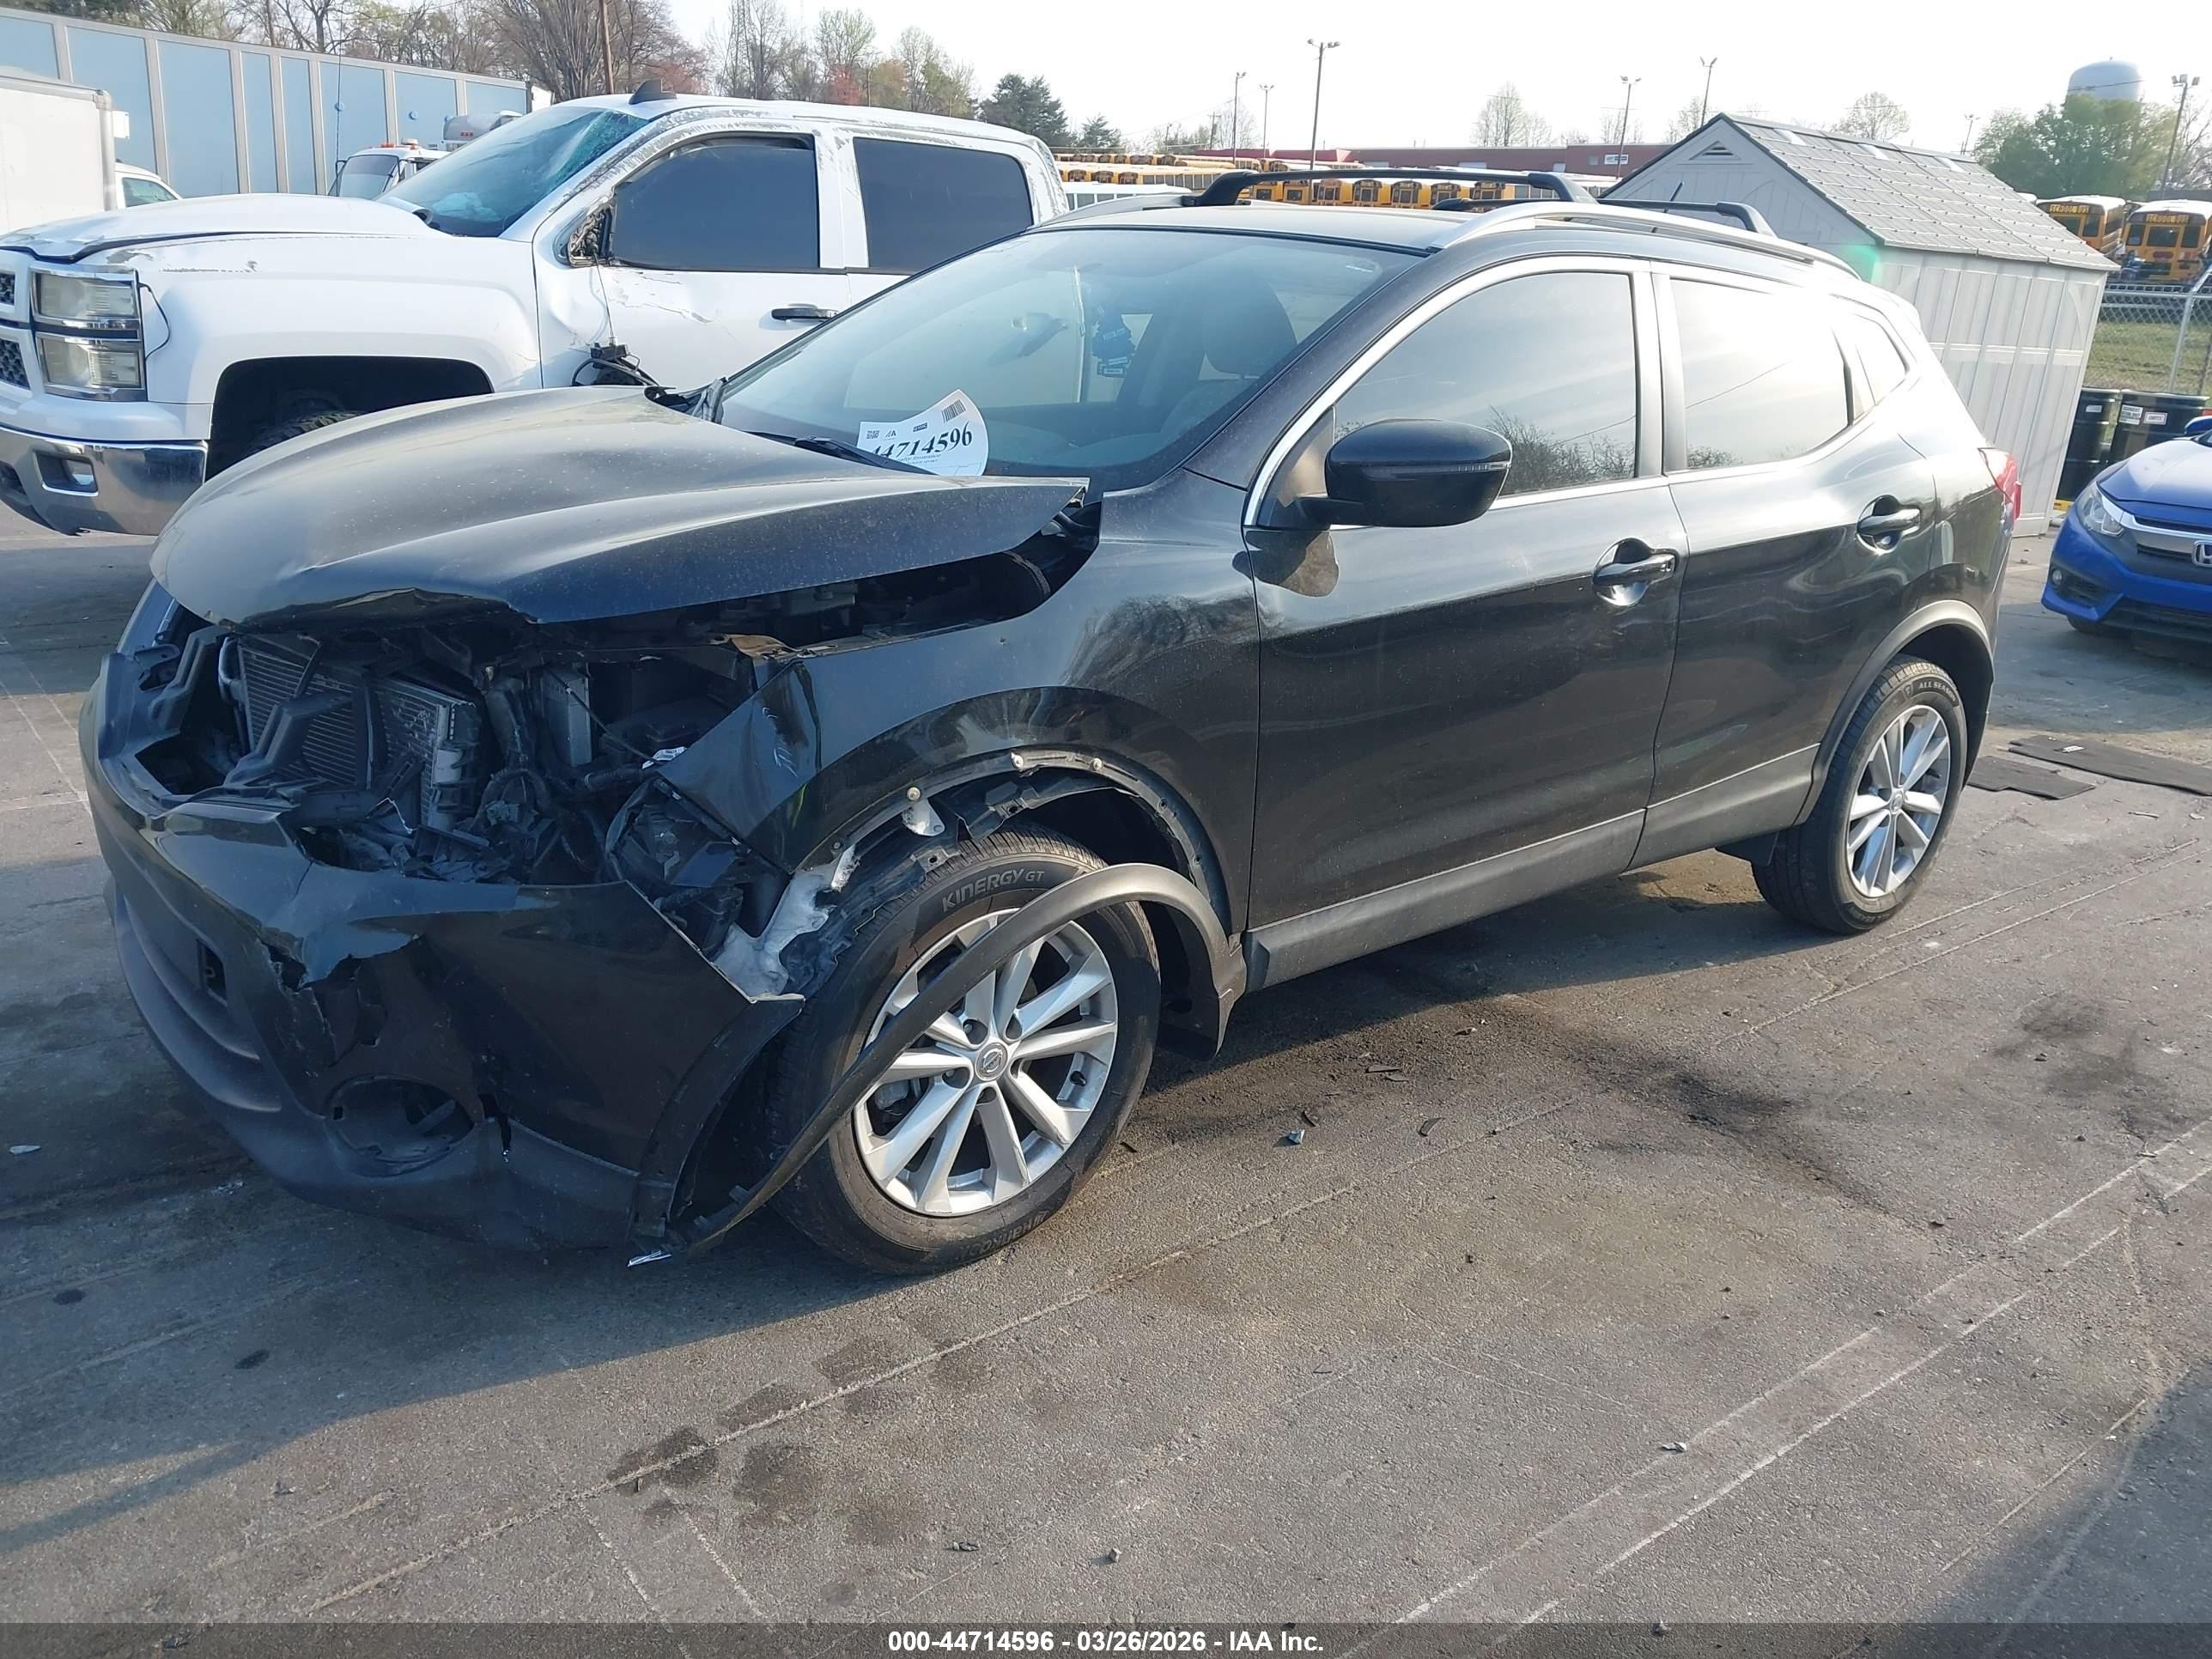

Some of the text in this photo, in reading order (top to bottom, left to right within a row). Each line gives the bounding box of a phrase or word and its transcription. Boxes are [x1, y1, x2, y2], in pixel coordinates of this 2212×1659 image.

[1919, 680, 1933, 690] ALL
[941, 868, 1045, 913] KINERGY GT
